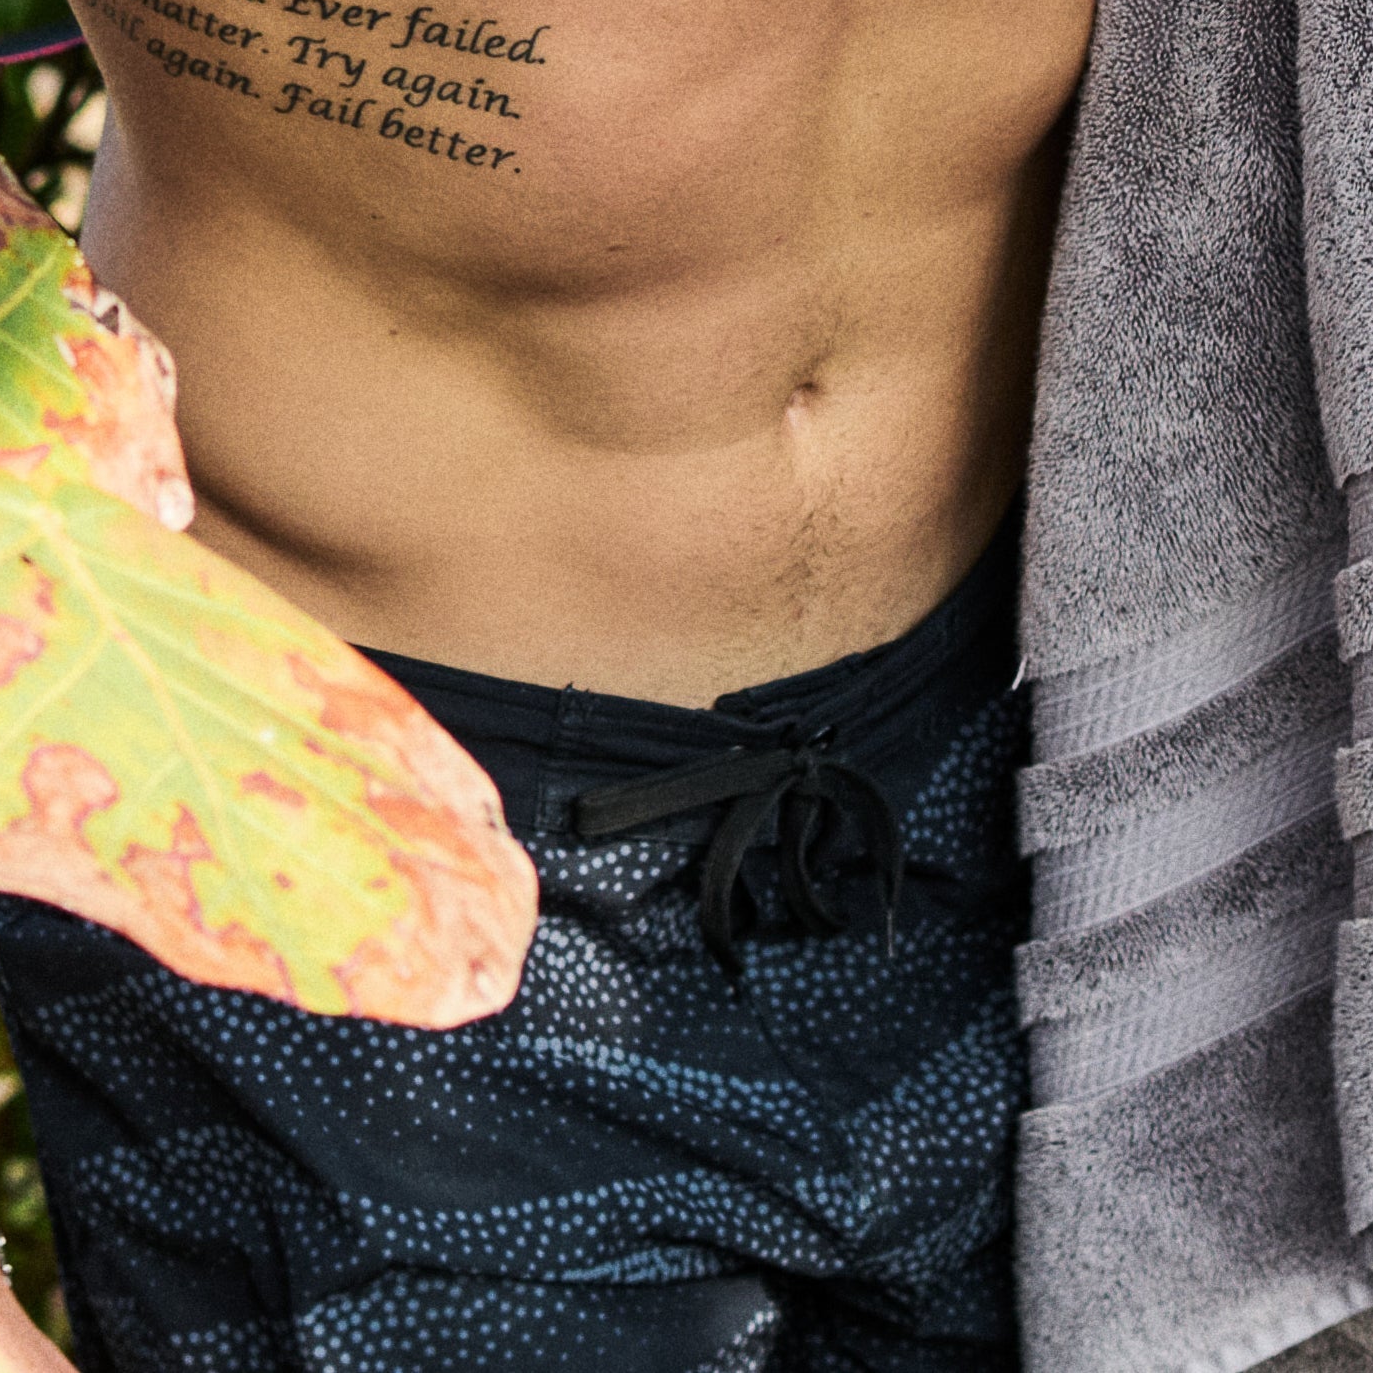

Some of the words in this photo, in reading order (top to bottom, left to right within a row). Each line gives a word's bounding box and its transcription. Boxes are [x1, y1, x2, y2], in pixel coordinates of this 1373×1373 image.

[287, 35, 367, 88] Try
[381, 66, 520, 120] again.
[390, 7, 551, 65] failed.
[146, 38, 261, 99] again.
[275, 83, 377, 129] Fail
[379, 107, 522, 174] better.
